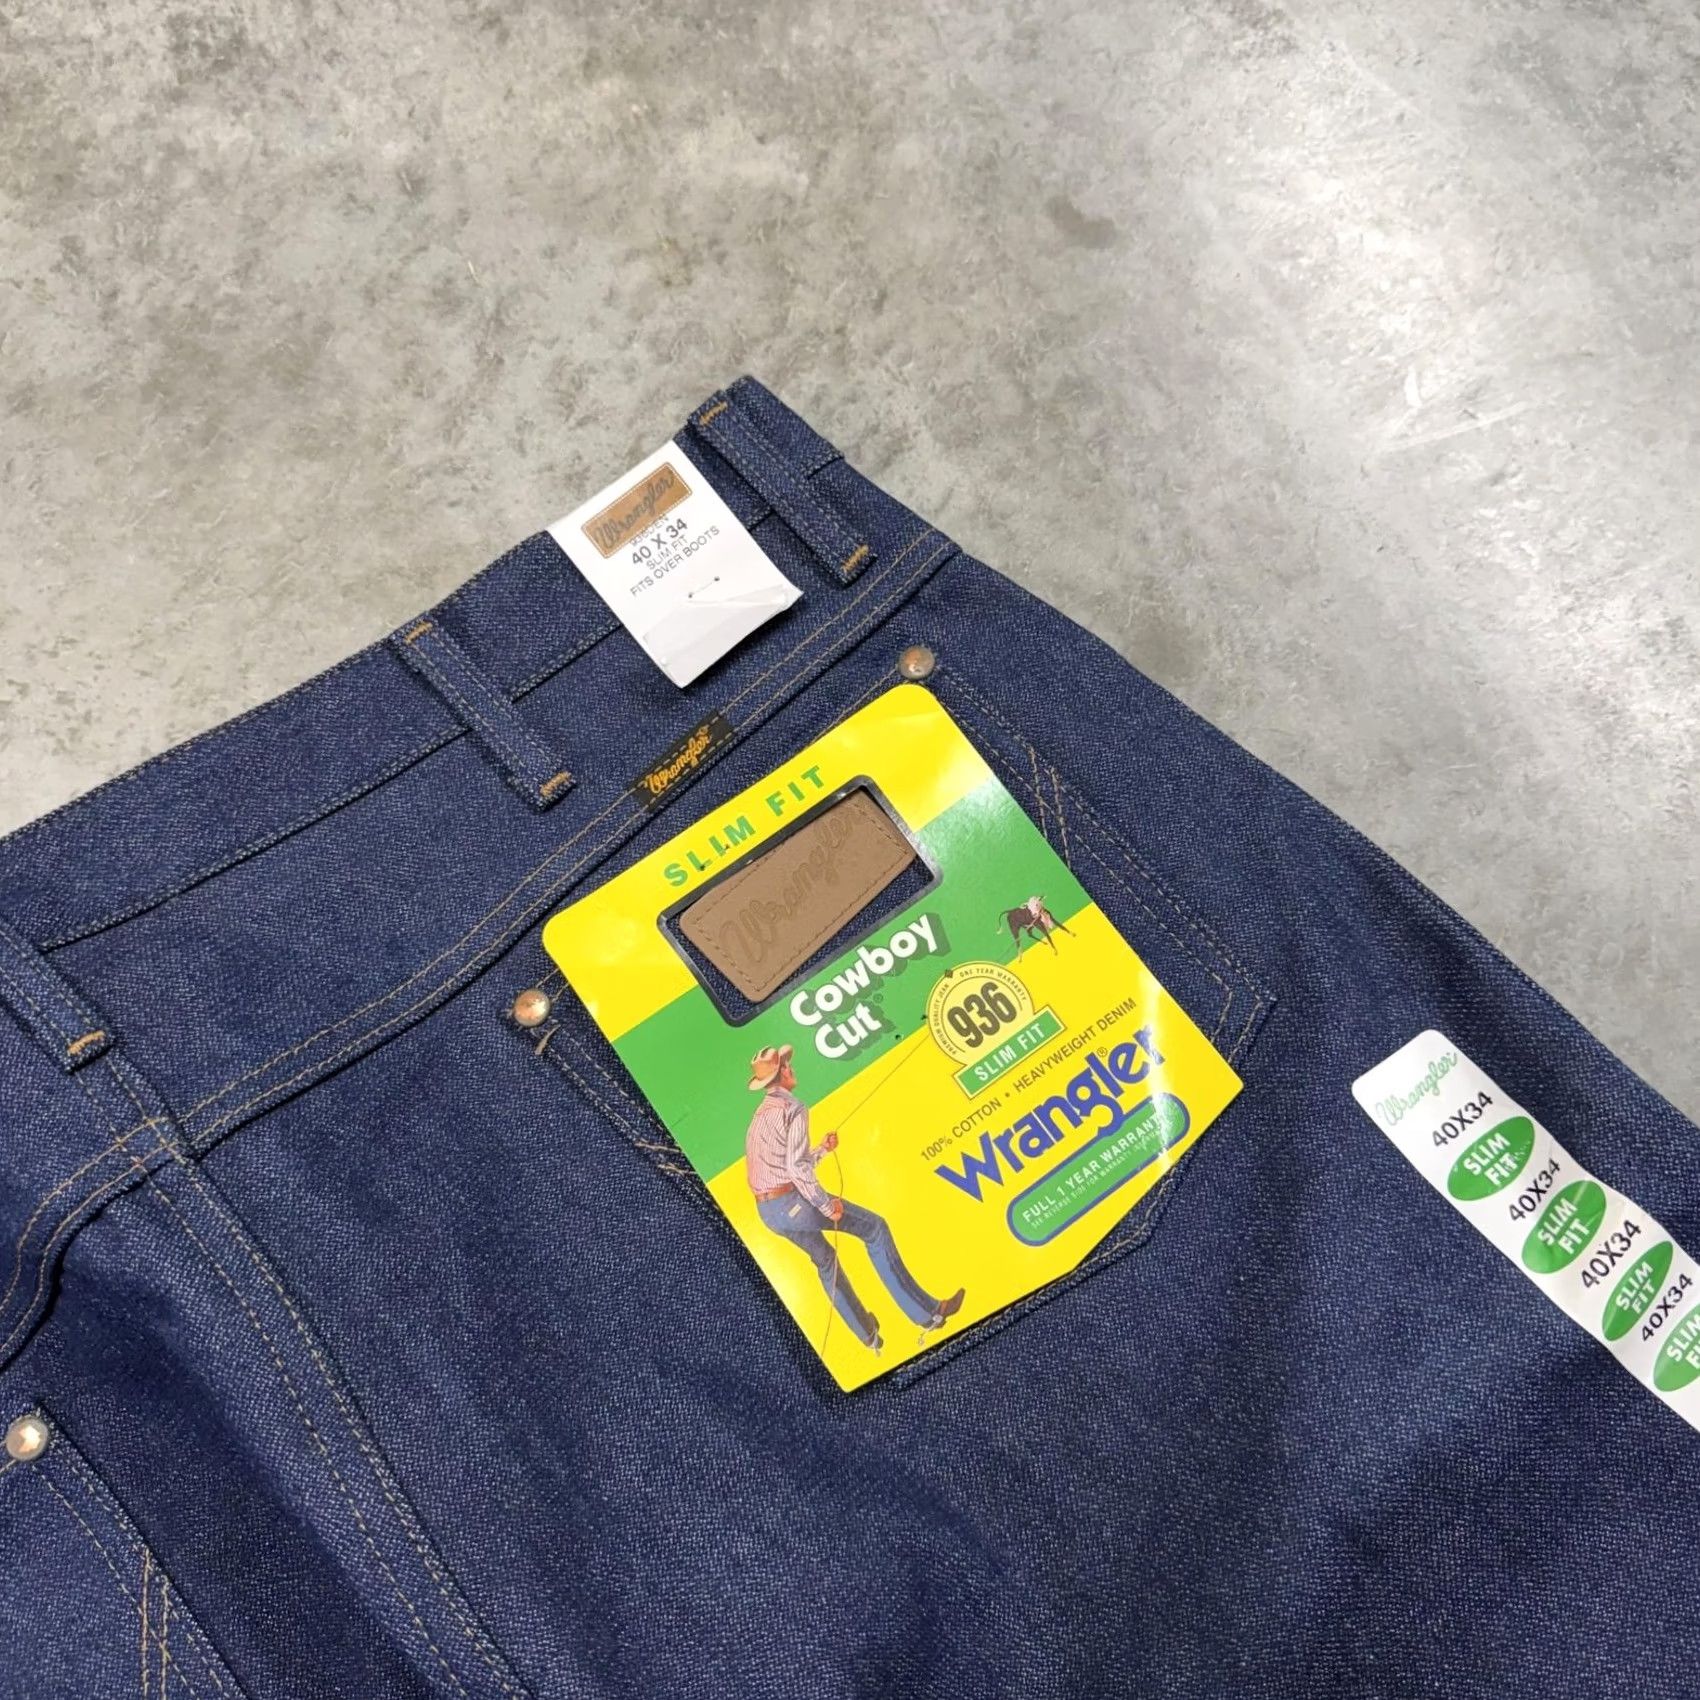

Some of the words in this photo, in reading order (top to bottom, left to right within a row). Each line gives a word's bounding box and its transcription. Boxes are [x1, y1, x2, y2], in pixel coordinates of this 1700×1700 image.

[593, 476, 675, 549] Wrangler
[632, 545, 652, 565] 40
[651, 533, 667, 549] X
[665, 518, 688, 539] 34
[630, 575, 654, 596] FITS
[653, 554, 684, 580] OVER
[682, 525, 720, 557] BOOTS
[645, 550, 672, 570] SLIM
[671, 534, 689, 554] FIT
[644, 734, 712, 793] Wrangler
[663, 815, 757, 887] SLIM
[766, 765, 824, 817] FIT
[720, 806, 866, 963] Wrangler
[790, 914, 938, 1026] Cowboy
[815, 1002, 882, 1059] Cut
[947, 982, 1017, 1048] 936
[920, 1135, 953, 1161] 100%
[952, 1097, 1002, 1139] COTTON
[1012, 1027, 1097, 1092] HEAVYWEIGHT
[1095, 997, 1137, 1032] DENIM
[974, 1045, 1017, 1082] SLIM
[1017, 1023, 1045, 1051] FIT
[934, 1025, 1166, 1203] Wrangler
[1376, 1051, 1458, 1126] Wrangler
[1432, 1091, 1493, 1147] 40X34
[1022, 1196, 1056, 1223] FULL
[1056, 1185, 1066, 1197] 1
[1065, 1159, 1101, 1189] YEAR
[1099, 1111, 1166, 1163] WARRANT
[1463, 1132, 1511, 1176] SLIM
[1484, 1152, 1520, 1187] FIT
[1508, 1158, 1561, 1221] 40X34
[1538, 1197, 1578, 1247] SLIM
[1559, 1218, 1590, 1255] FIT
[1581, 1220, 1641, 1288] 40X34
[1615, 1261, 1654, 1311] SLIM
[1631, 1281, 1658, 1314] FIT
[1640, 1273, 1694, 1341] 40X34
